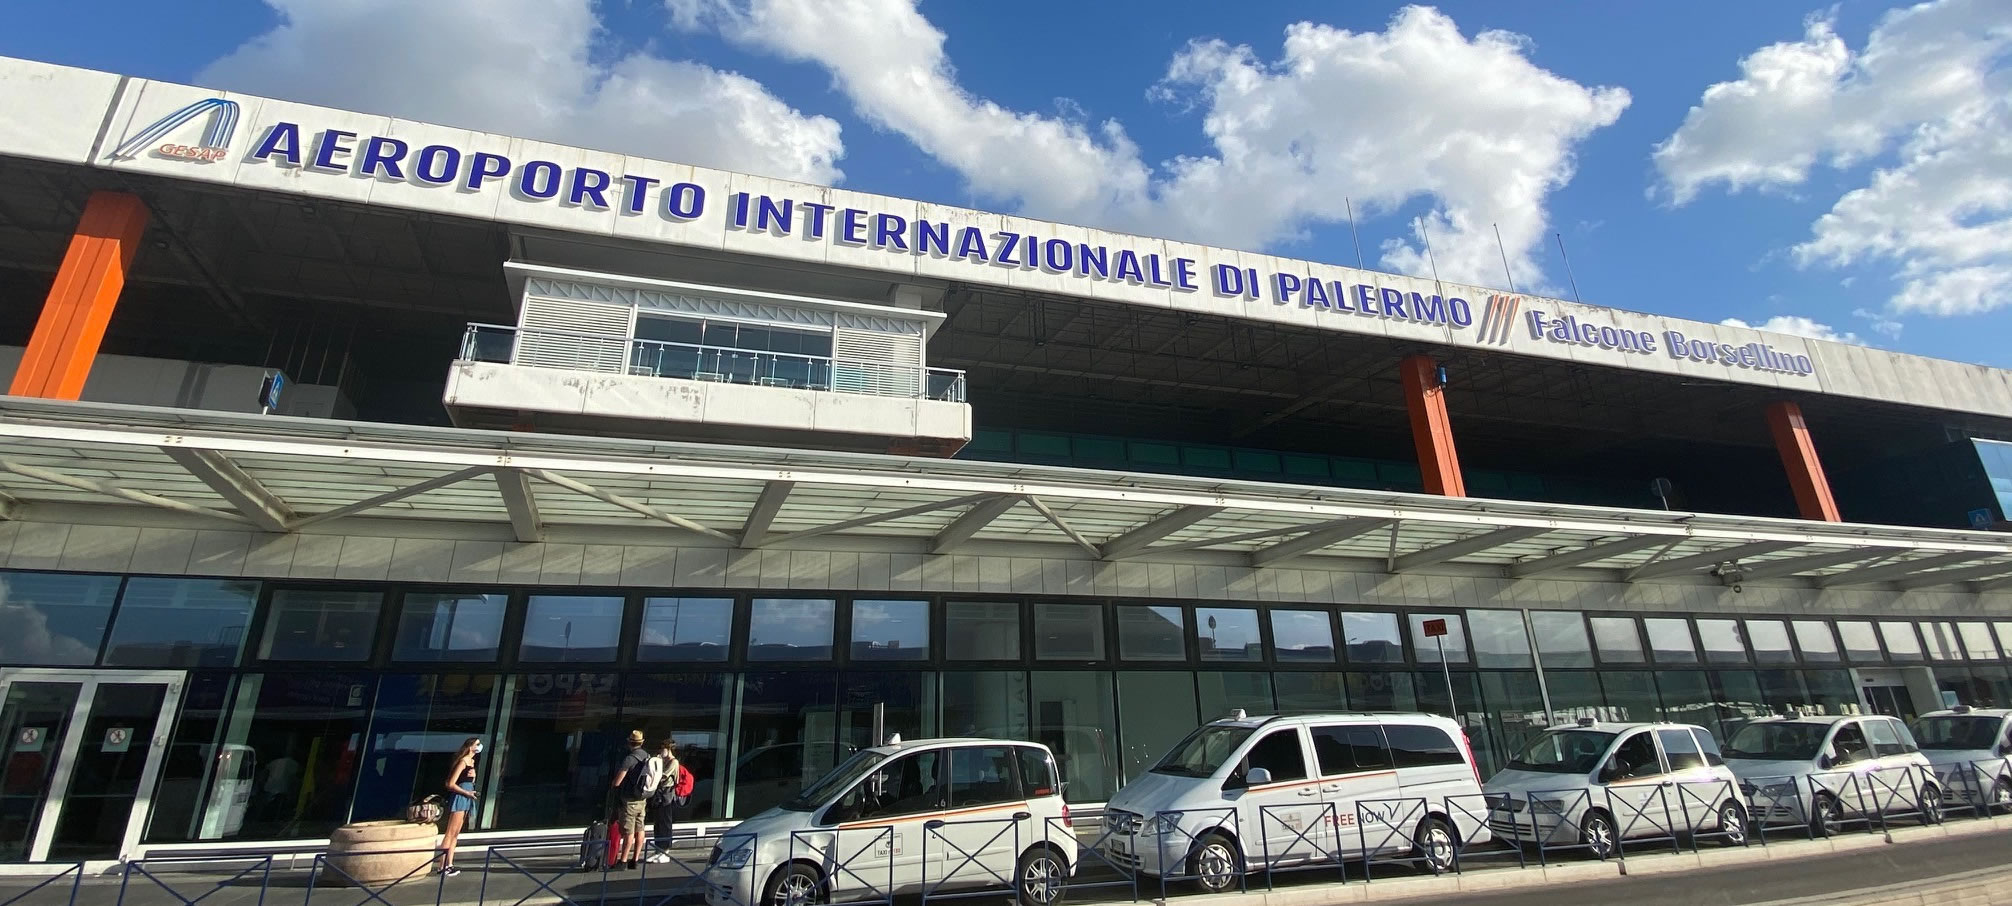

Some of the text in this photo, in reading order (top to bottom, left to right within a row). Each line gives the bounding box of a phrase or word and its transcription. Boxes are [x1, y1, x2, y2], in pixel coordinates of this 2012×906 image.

[160, 143, 227, 161] GESAP
[254, 121, 1812, 374] AEROPORTO INTERNAZIONALE DI PALERMO Falcone Borsellino
